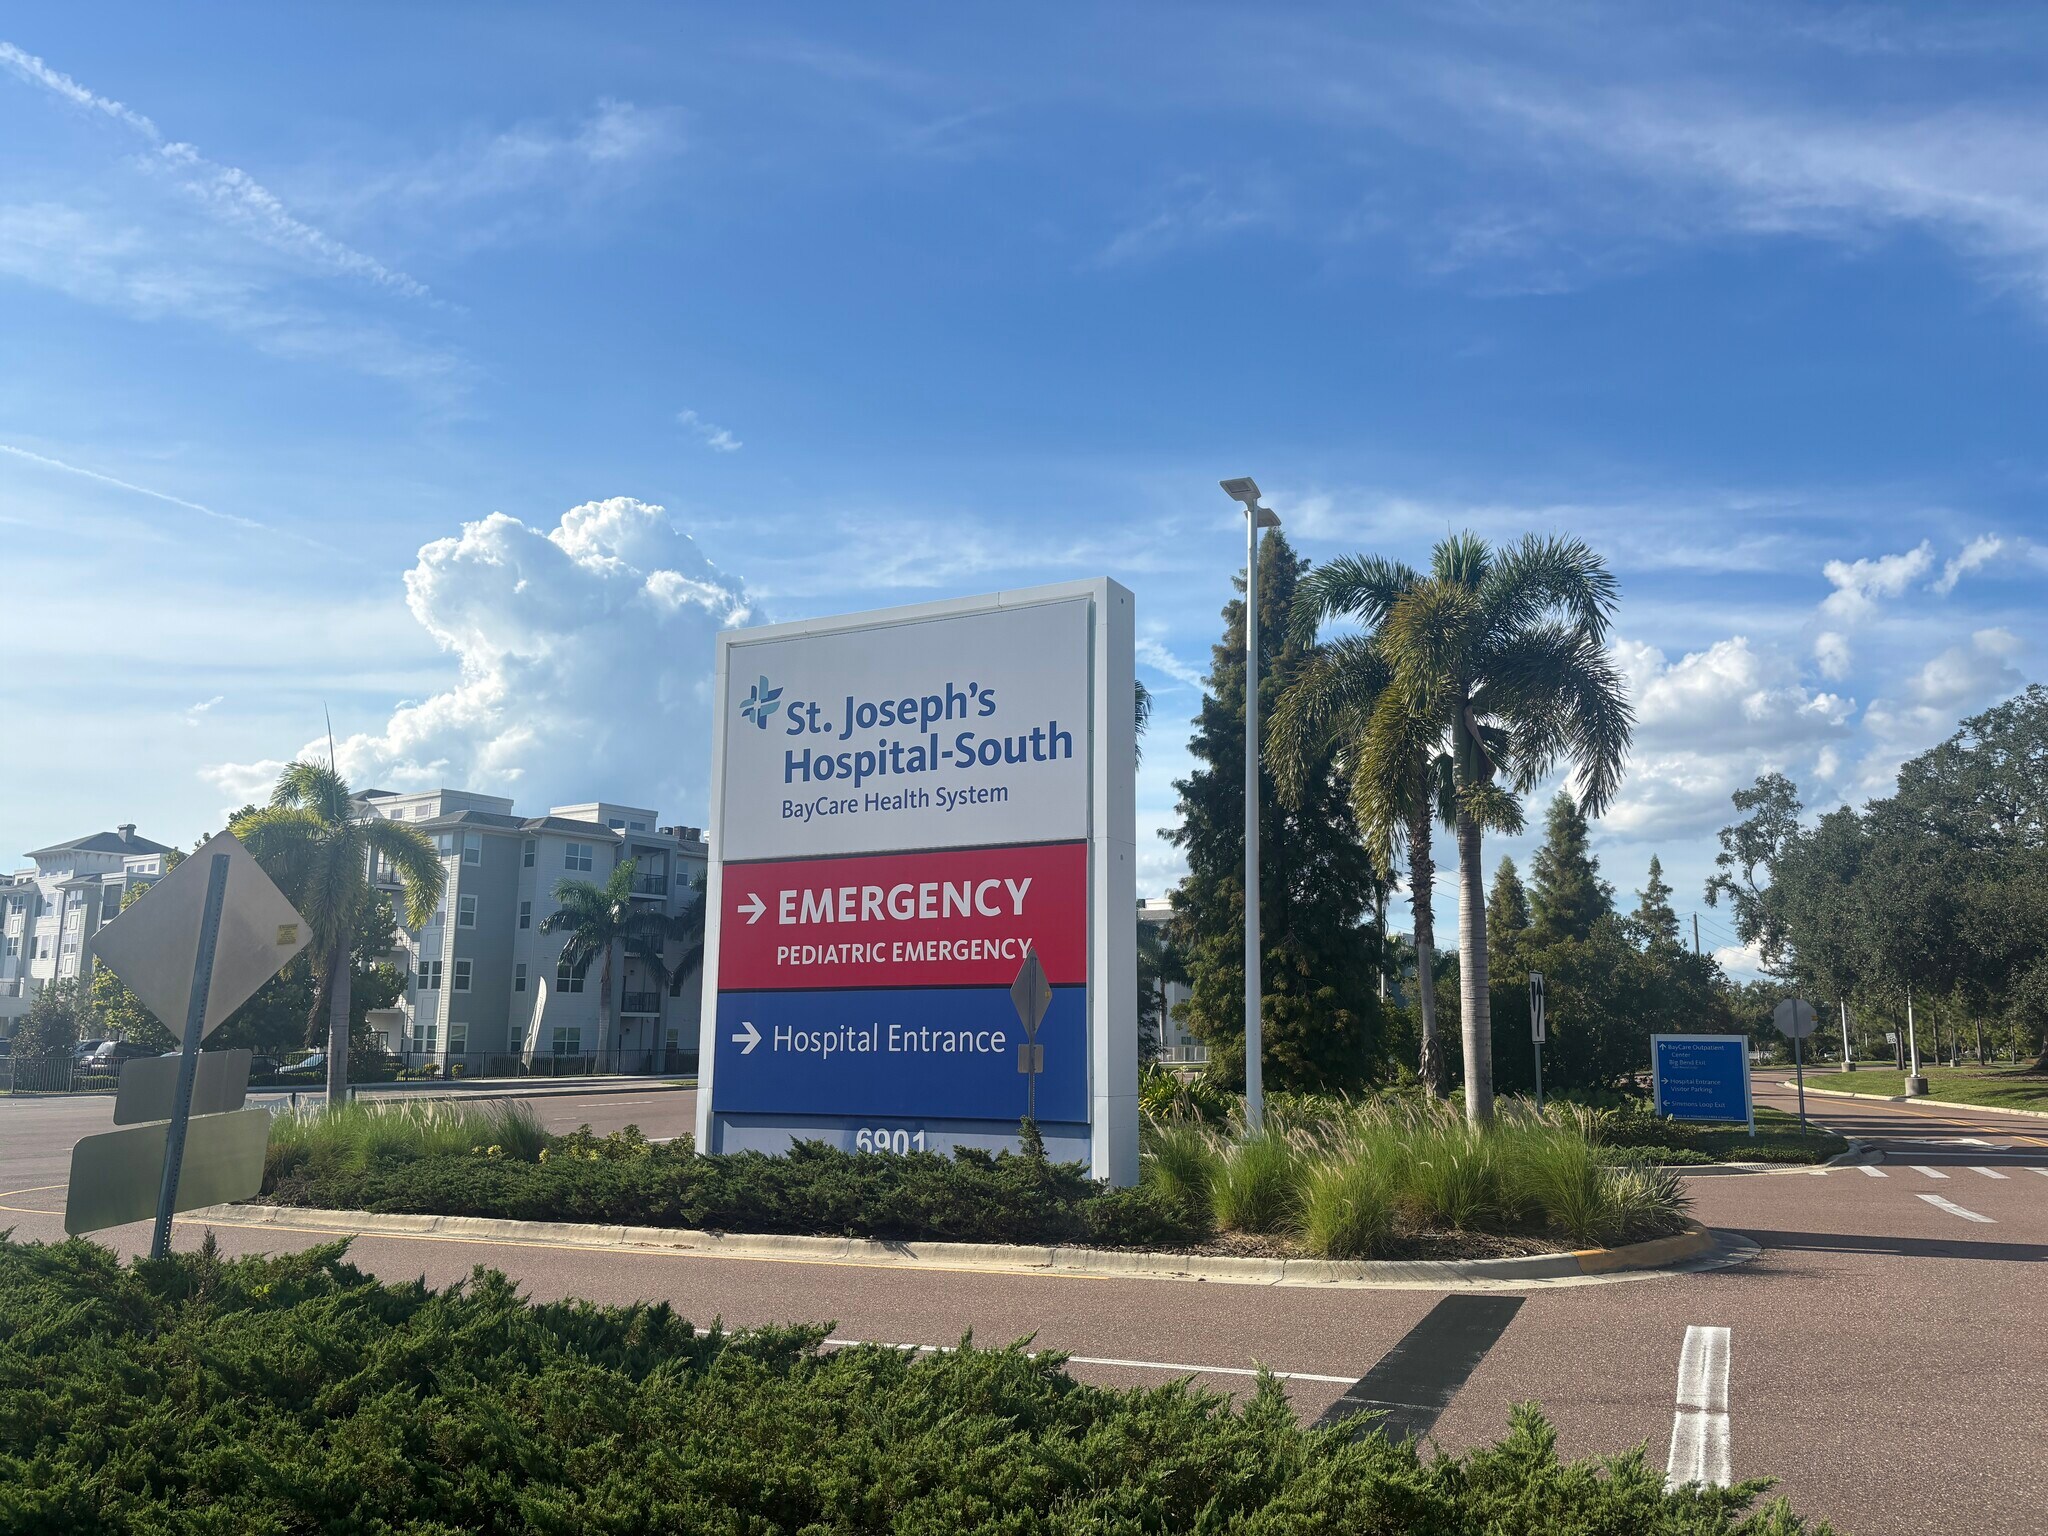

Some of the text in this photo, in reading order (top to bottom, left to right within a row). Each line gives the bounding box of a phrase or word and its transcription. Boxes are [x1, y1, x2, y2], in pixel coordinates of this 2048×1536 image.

[785, 681, 997, 741] St. Joseph's
[784, 720, 1073, 789] Hospital-South
[782, 784, 1009, 823] BayCare Health System
[778, 877, 1033, 925] EMERGENCY
[776, 937, 1033, 966] PEDIATRIC EMERGENCY
[773, 1022, 1007, 1061] Hospital Entrance
[1669, 1059, 1679, 1067] Big
[1670, 1078, 1695, 1086] Hospital
[1690, 1086, 1713, 1094] Parking
[1699, 1101, 1714, 1109] Loop
[856, 1127, 925, 1158] 6901
